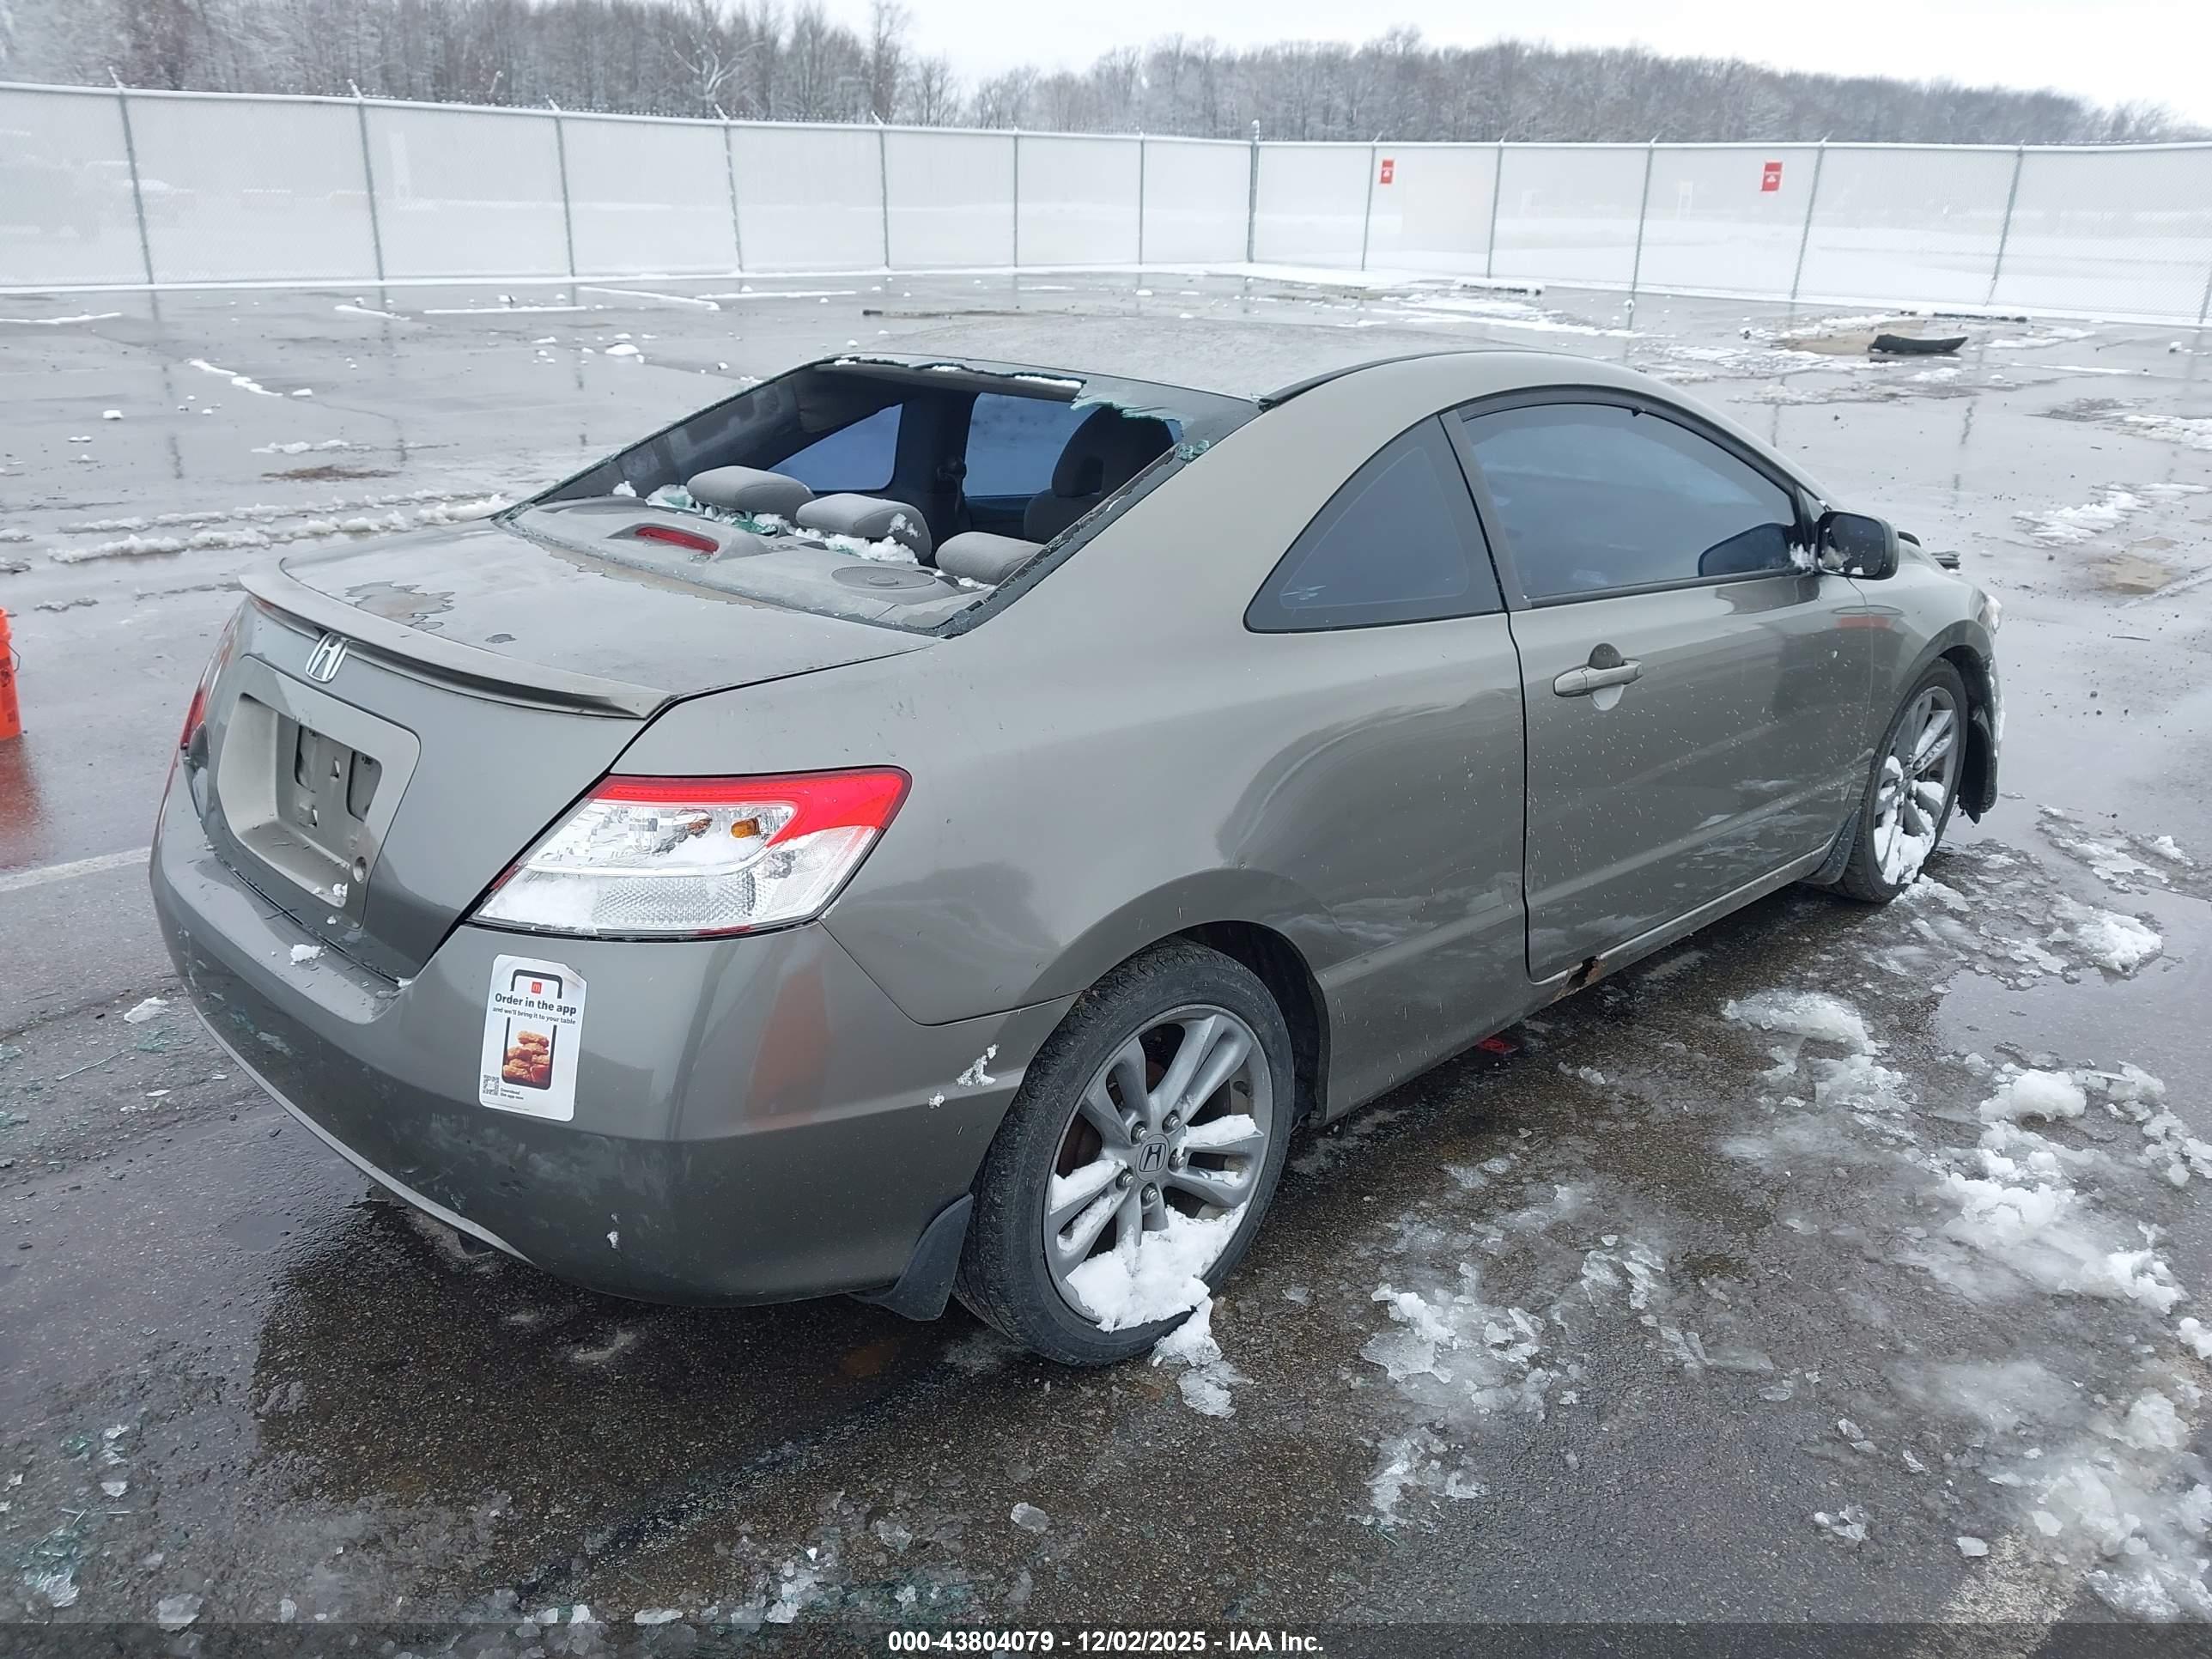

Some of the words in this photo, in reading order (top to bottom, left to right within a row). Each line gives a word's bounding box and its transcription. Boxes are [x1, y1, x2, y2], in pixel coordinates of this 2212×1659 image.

[495, 993, 524, 1006] Order
[525, 997, 535, 1007] in
[537, 1000, 555, 1011] the
[556, 1005, 577, 1016] app
